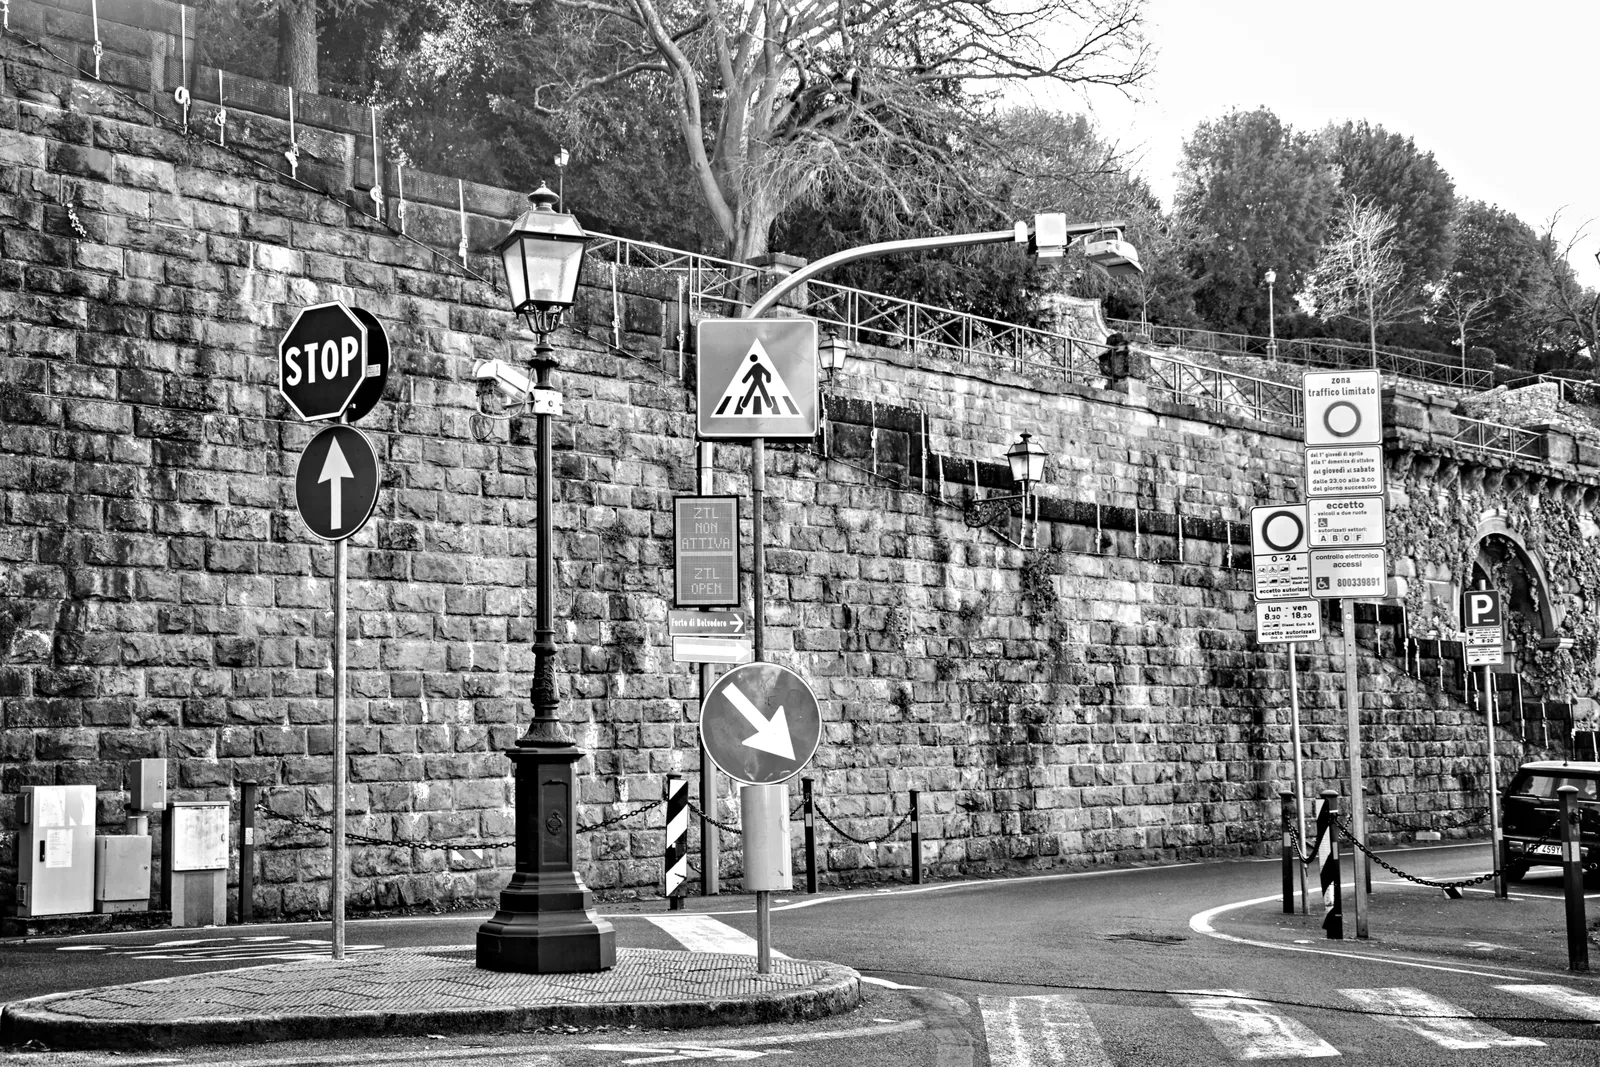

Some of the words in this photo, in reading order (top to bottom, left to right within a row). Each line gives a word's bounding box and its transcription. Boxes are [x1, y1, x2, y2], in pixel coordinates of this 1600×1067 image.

[285, 336, 359, 387] STOP
[1308, 388, 1340, 397] traffico
[1342, 386, 1376, 396] limitato
[1322, 466, 1345, 476] giovedì
[1353, 465, 1375, 473] sabato
[1326, 501, 1364, 509] eccetto
[693, 507, 719, 519] ZTL
[695, 522, 718, 534] NON
[681, 537, 730, 549] ATTIVA
[1285, 554, 1297, 562] 24
[694, 567, 720, 579] ZTL
[691, 582, 722, 595] OPEN
[1337, 577, 1381, 588] 800339891
[1471, 594, 1493, 624] P
[671, 617, 687, 627] Forte
[688, 618, 695, 627] di
[696, 618, 727, 627] Belvedere
